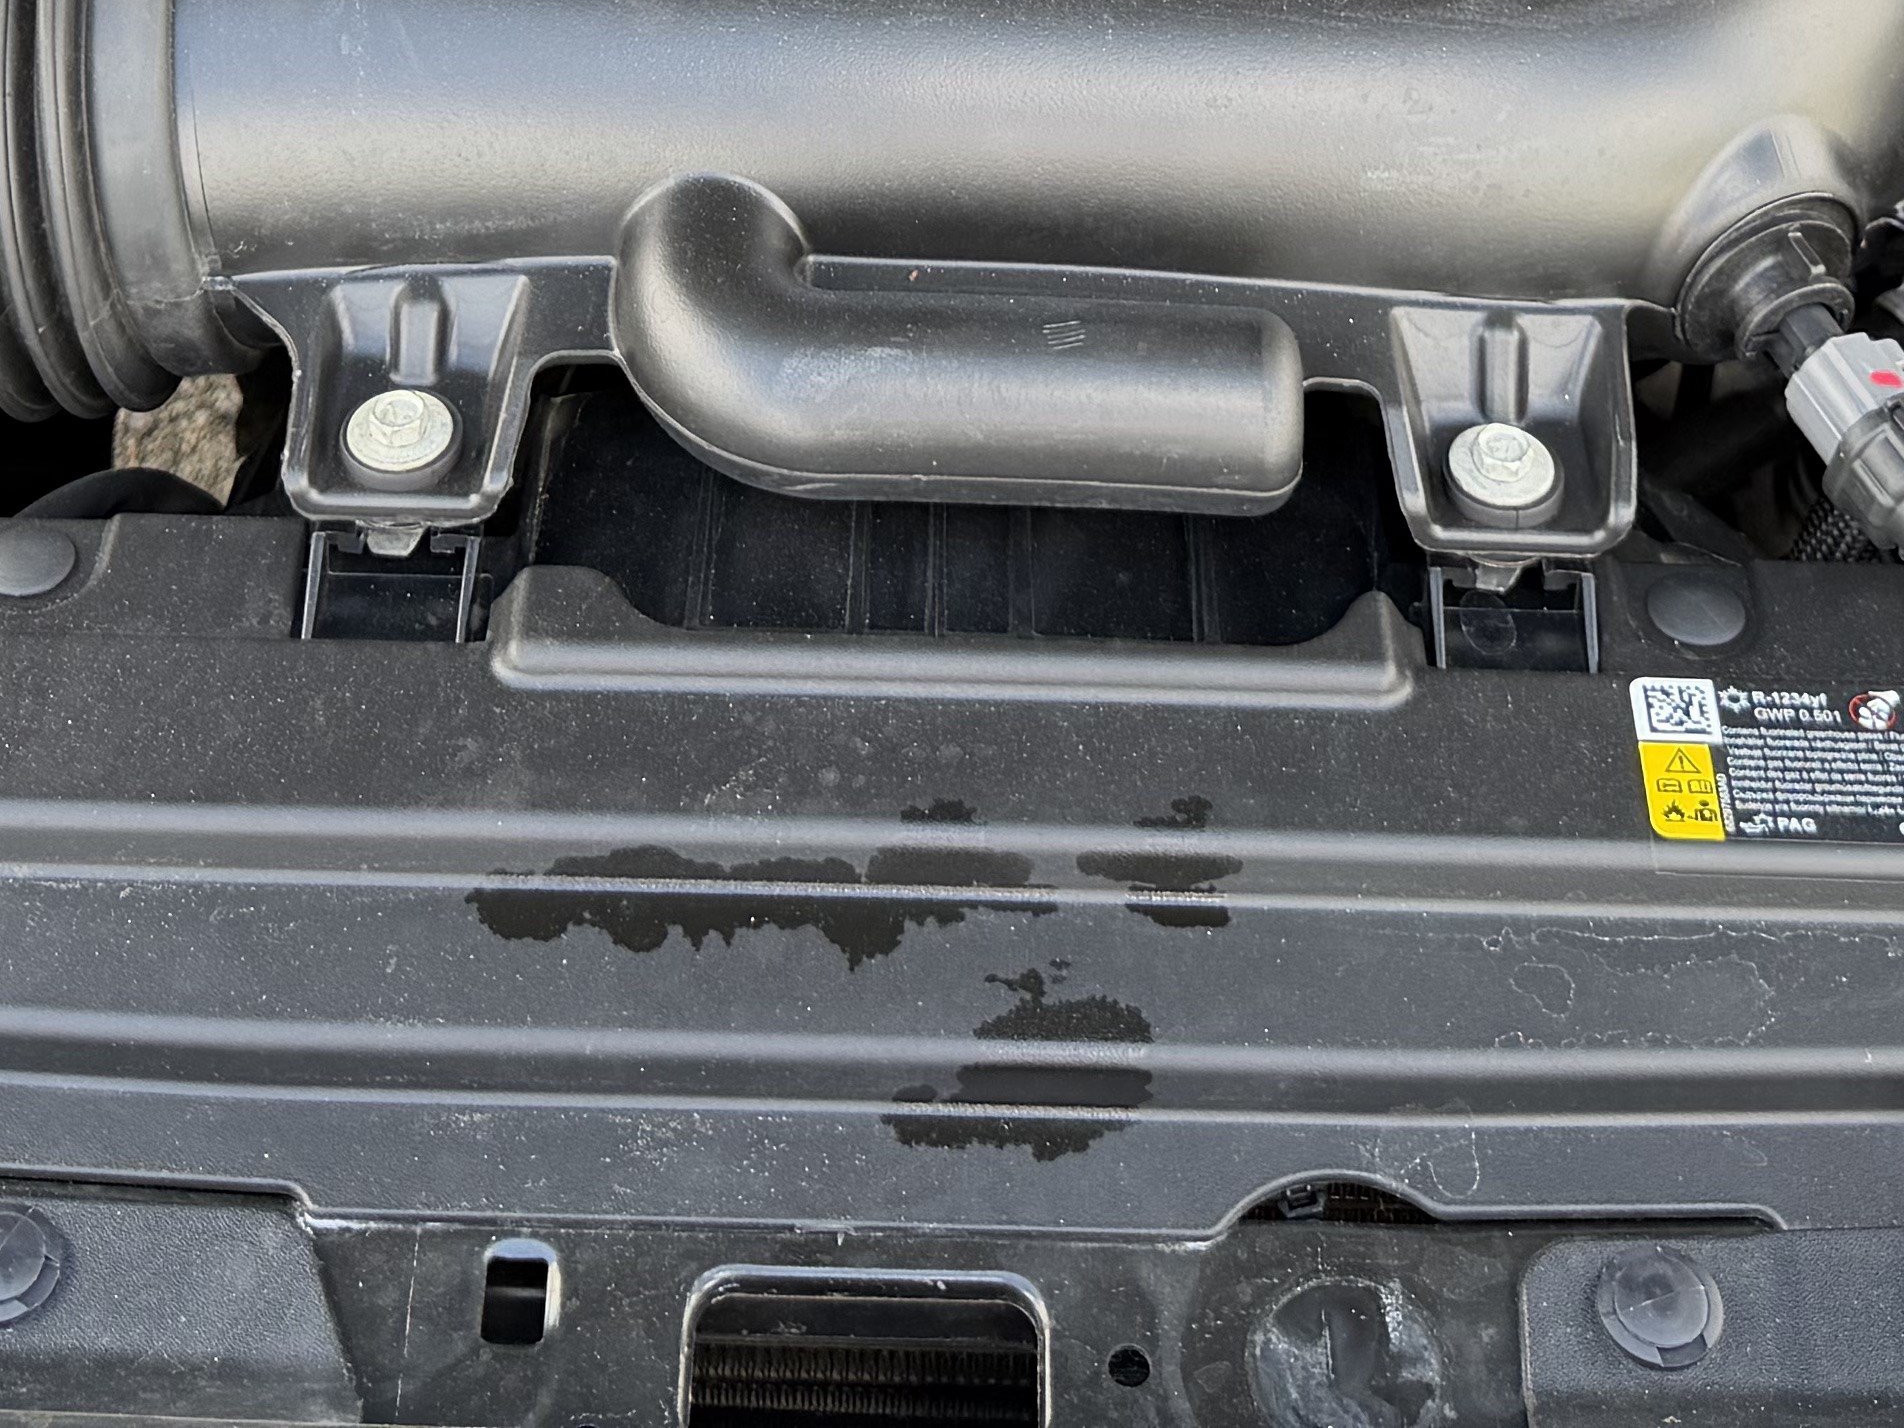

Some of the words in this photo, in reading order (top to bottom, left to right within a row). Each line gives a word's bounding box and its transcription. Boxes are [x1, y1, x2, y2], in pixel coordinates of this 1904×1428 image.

[1751, 690, 1828, 707] R-1234yf
[1753, 707, 1794, 722] GWP
[1798, 708, 1842, 724] 0.501
[1776, 817, 1817, 833] PAG
